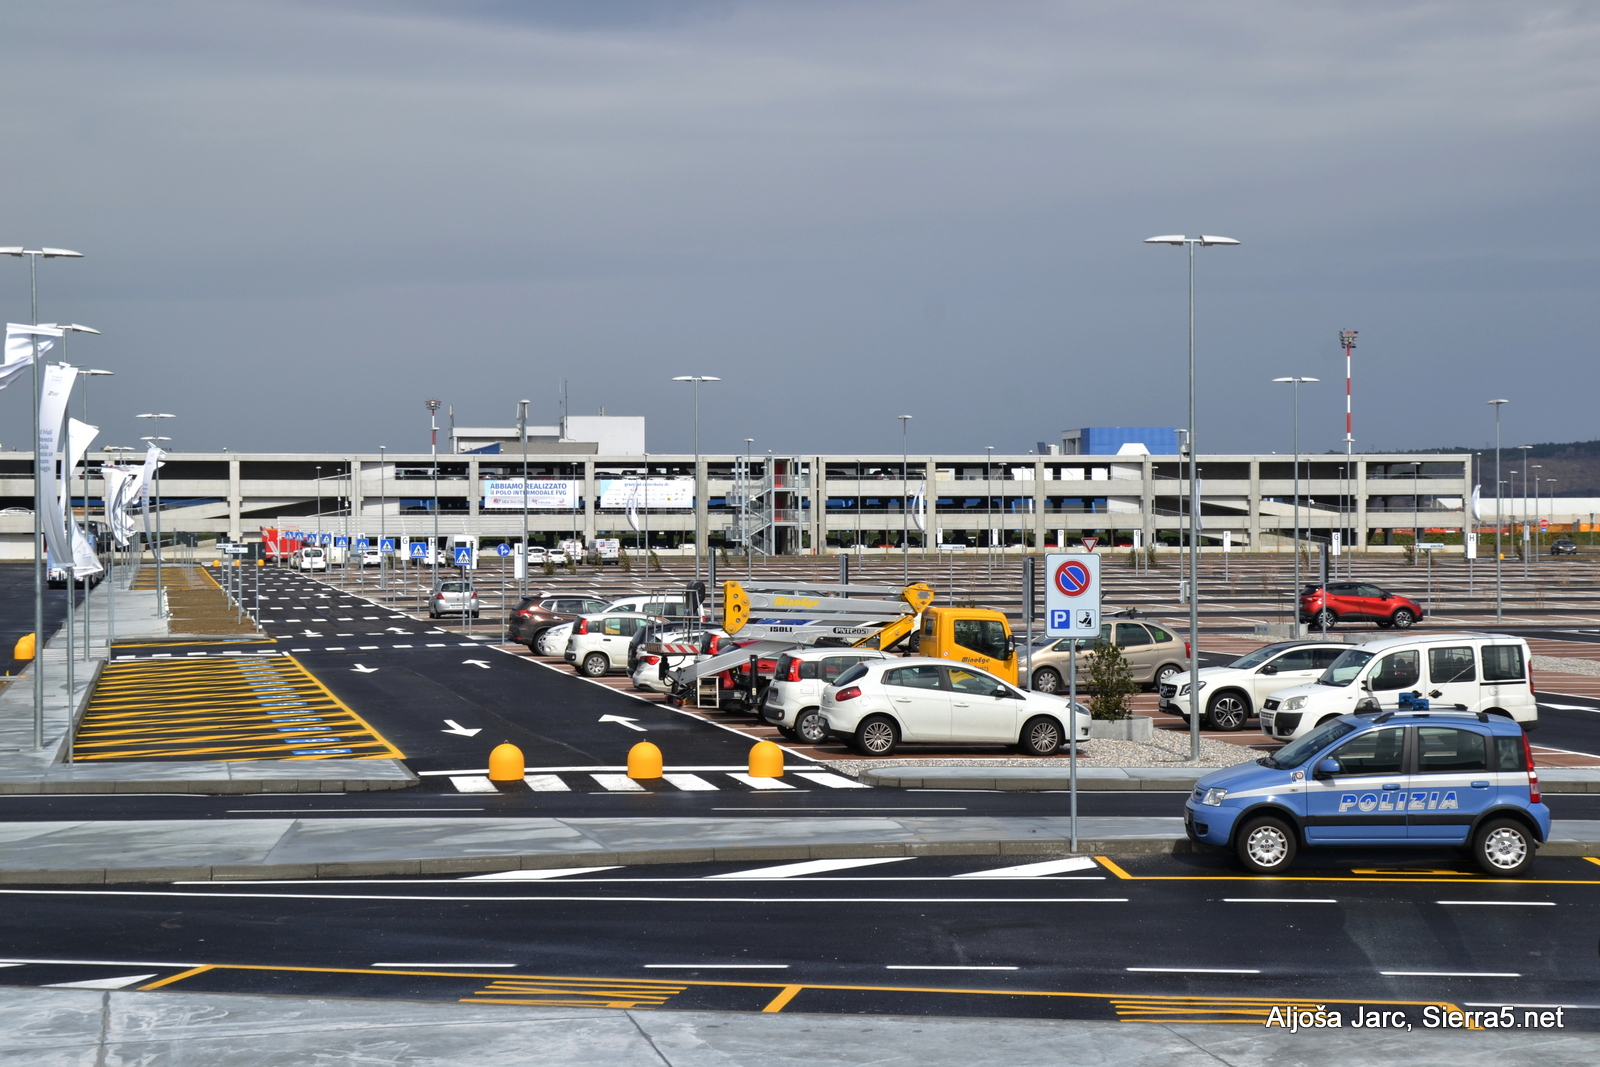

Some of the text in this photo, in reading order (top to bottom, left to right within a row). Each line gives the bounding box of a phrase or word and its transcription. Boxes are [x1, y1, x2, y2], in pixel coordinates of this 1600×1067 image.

[517, 545, 524, 555] L
[1054, 611, 1067, 627] P
[1338, 791, 1459, 813] POLIZIA
